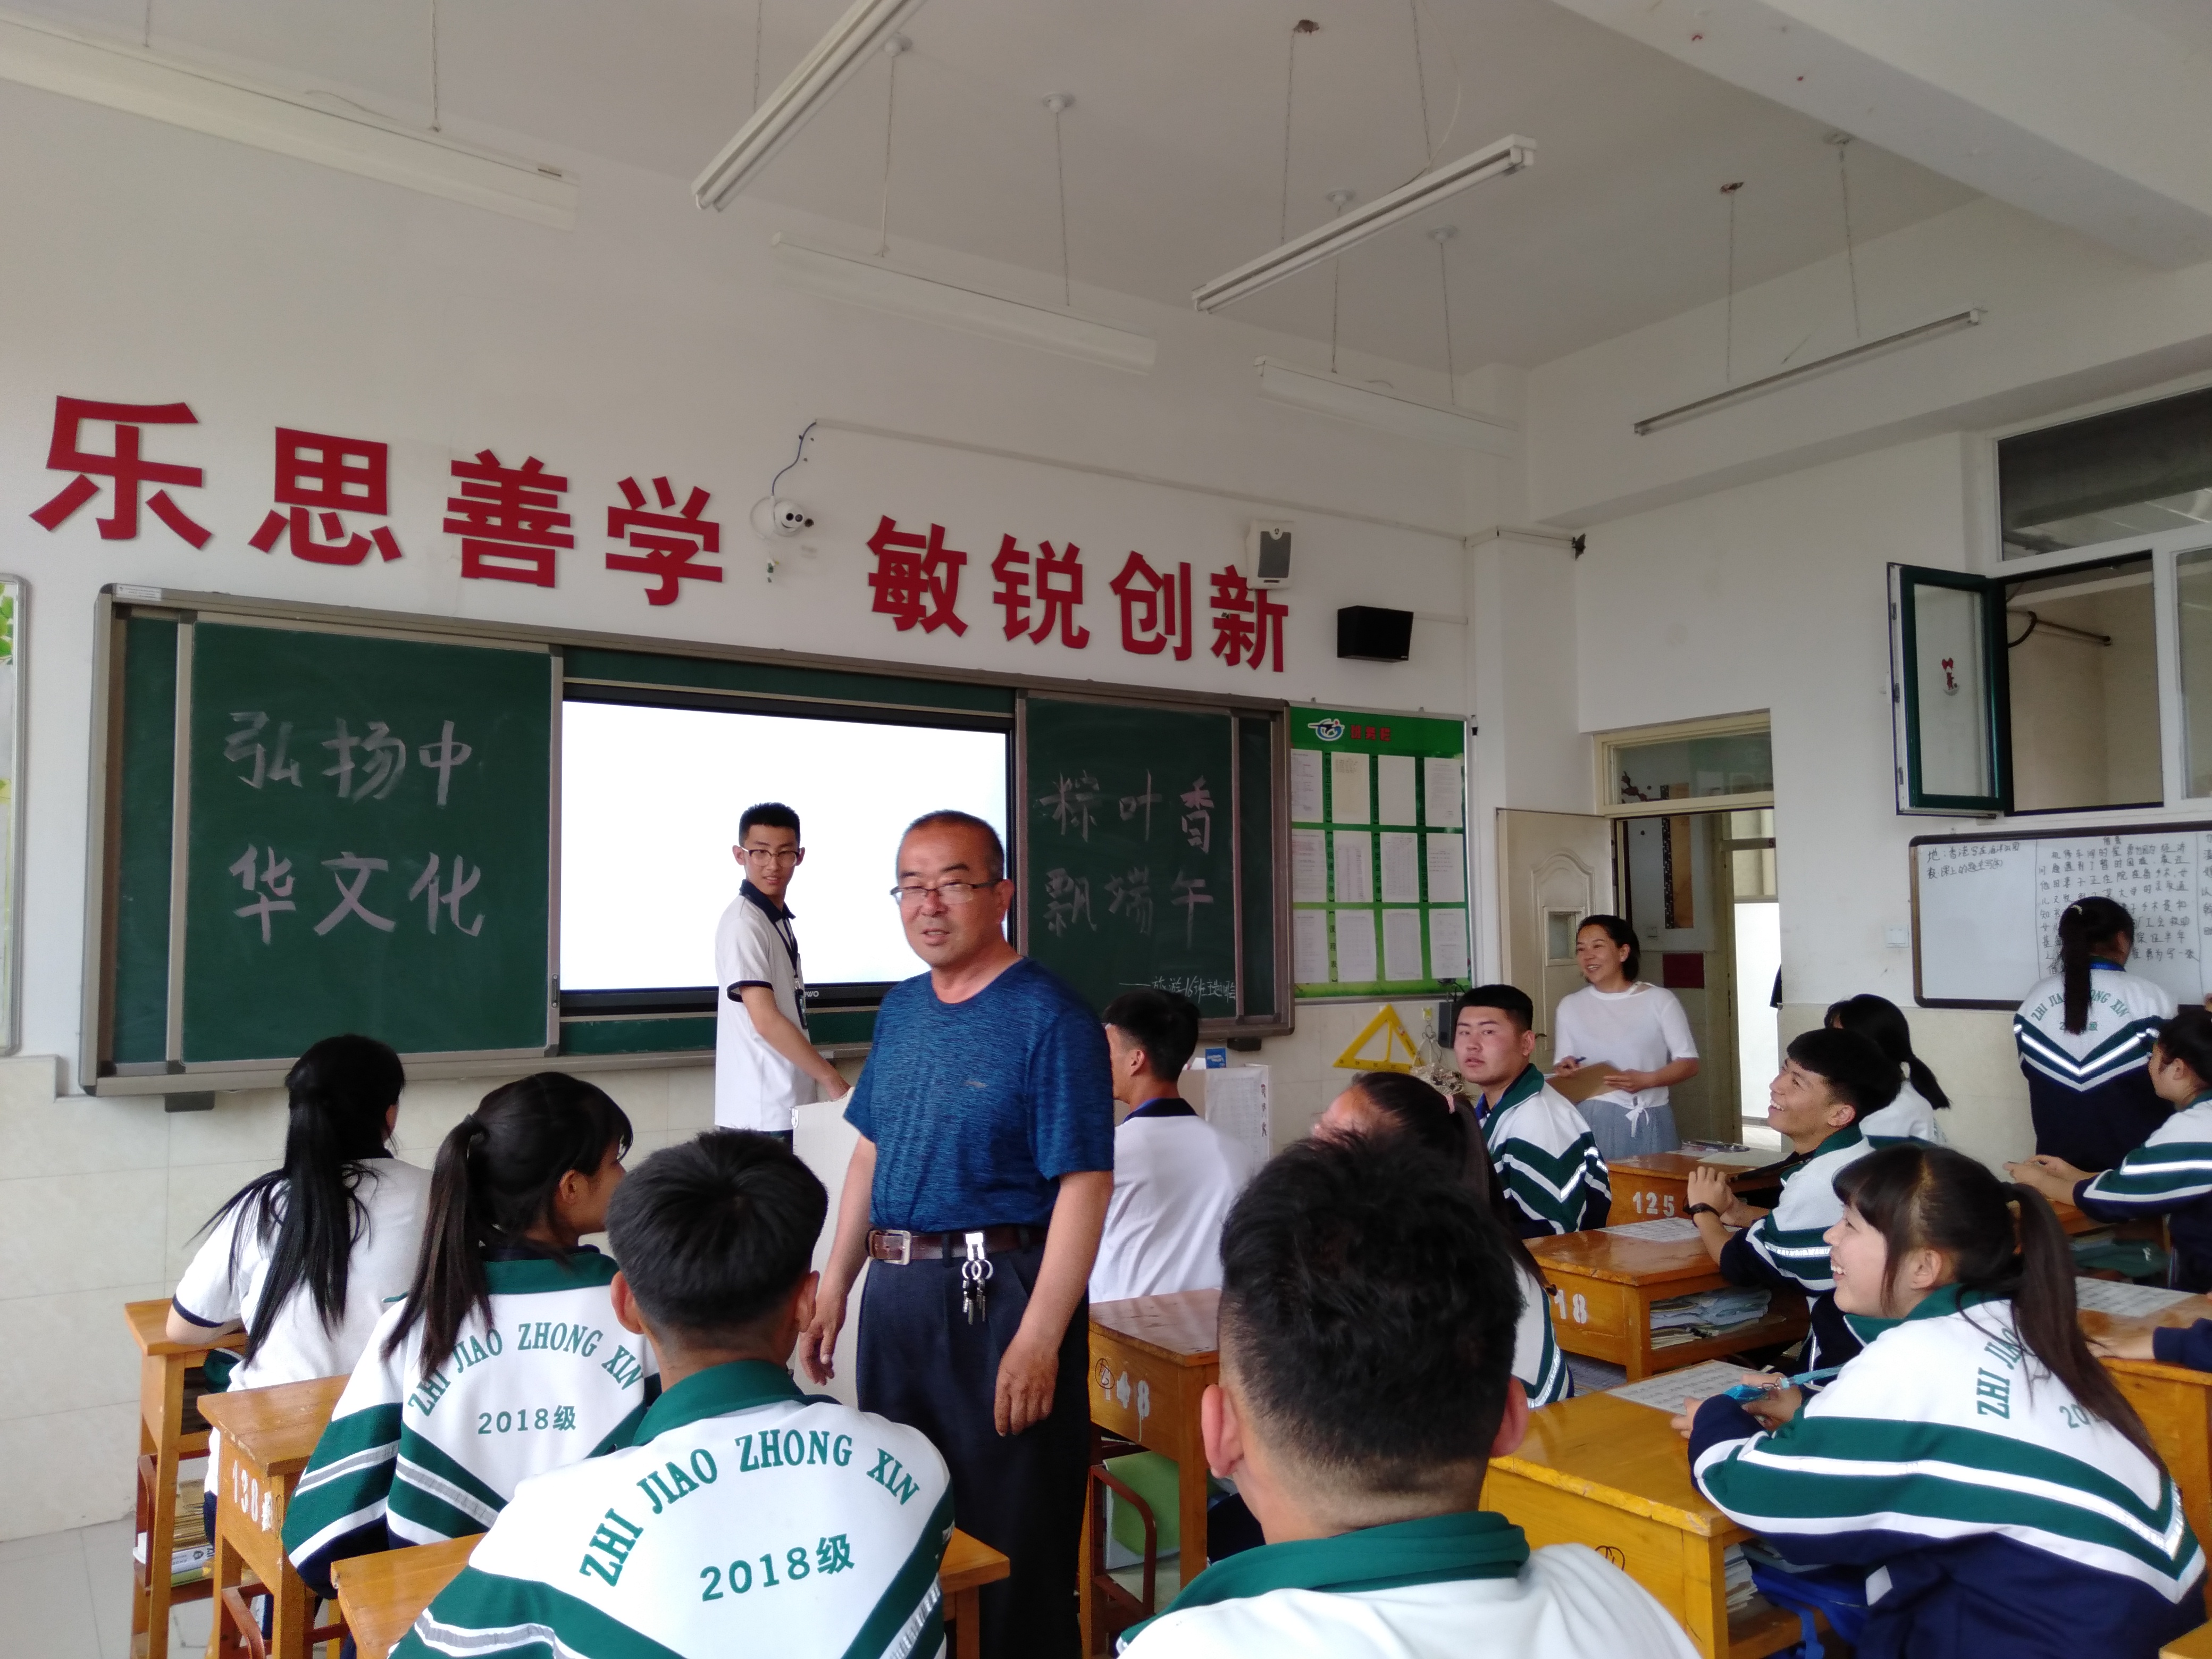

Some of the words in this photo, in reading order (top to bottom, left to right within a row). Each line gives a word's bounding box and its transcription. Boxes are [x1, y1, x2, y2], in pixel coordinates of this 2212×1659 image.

[32, 397, 722, 605] 乐思善学
[868, 517, 1288, 671] 敏锐创新
[223, 711, 473, 809] 弘扬中
[1039, 769, 1214, 854] 粽叶香
[229, 843, 484, 945] 华文化
[1043, 865, 1214, 951] 飘端午
[2031, 1003, 2048, 1021] ZHI
[2048, 993, 2065, 1007] JIA
[2110, 999, 2129, 1017] XIN
[1632, 1191, 1674, 1217] 125
[1554, 1289, 1587, 1324] 18
[407, 1369, 451, 1417] ZHI
[452, 1328, 503, 1373] JIAO
[517, 1322, 604, 1357] ZHONG
[601, 1345, 644, 1390] XIN
[1976, 1367, 2010, 1419] ZHI
[478, 1405, 576, 1435] 2018级
[579, 1508, 643, 1587] ZHI
[636, 1448, 718, 1514] JIAO
[735, 1429, 852, 1472] ZHONG
[866, 1448, 920, 1506] XIN
[700, 1534, 854, 1602] 2018级
